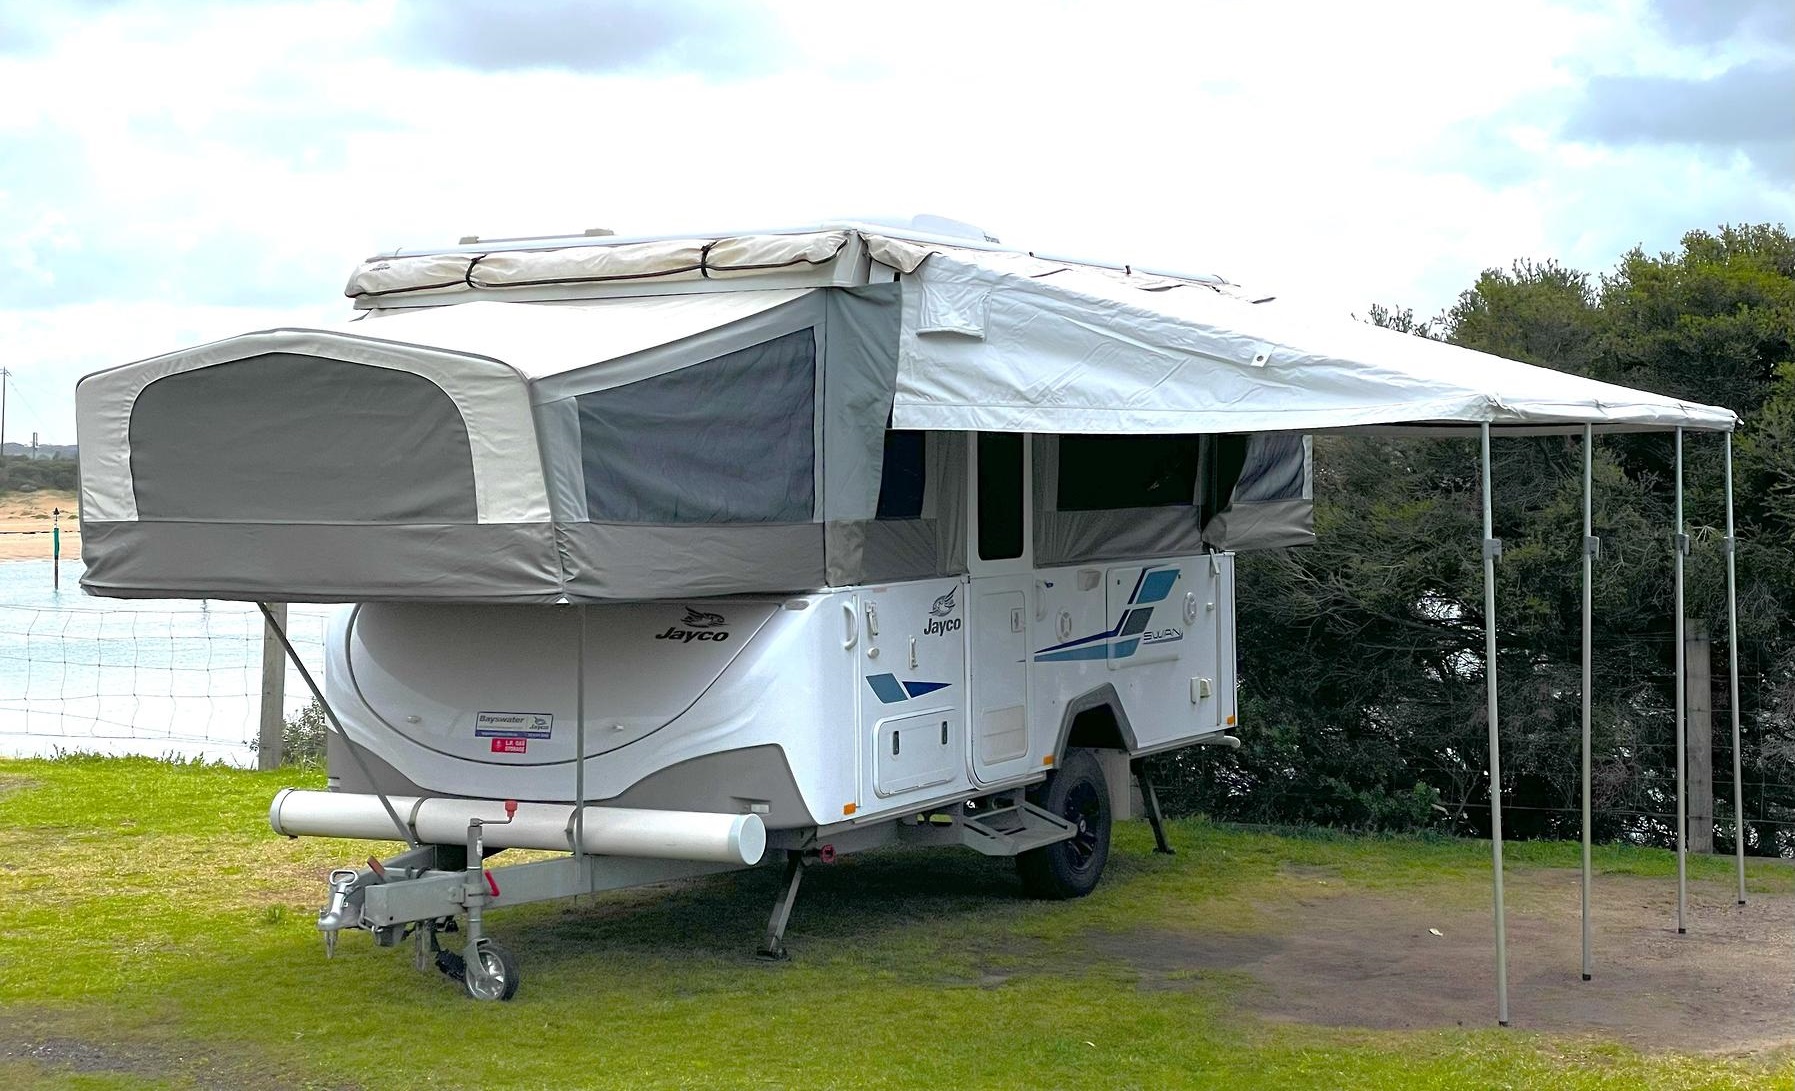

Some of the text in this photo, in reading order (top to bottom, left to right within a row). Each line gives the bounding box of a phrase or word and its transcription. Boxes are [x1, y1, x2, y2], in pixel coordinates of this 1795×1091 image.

[923, 617, 962, 637] Jayco
[1143, 628, 1184, 641] SWAN
[655, 626, 729, 644] Jayco
[479, 715, 525, 724] Bayswater
